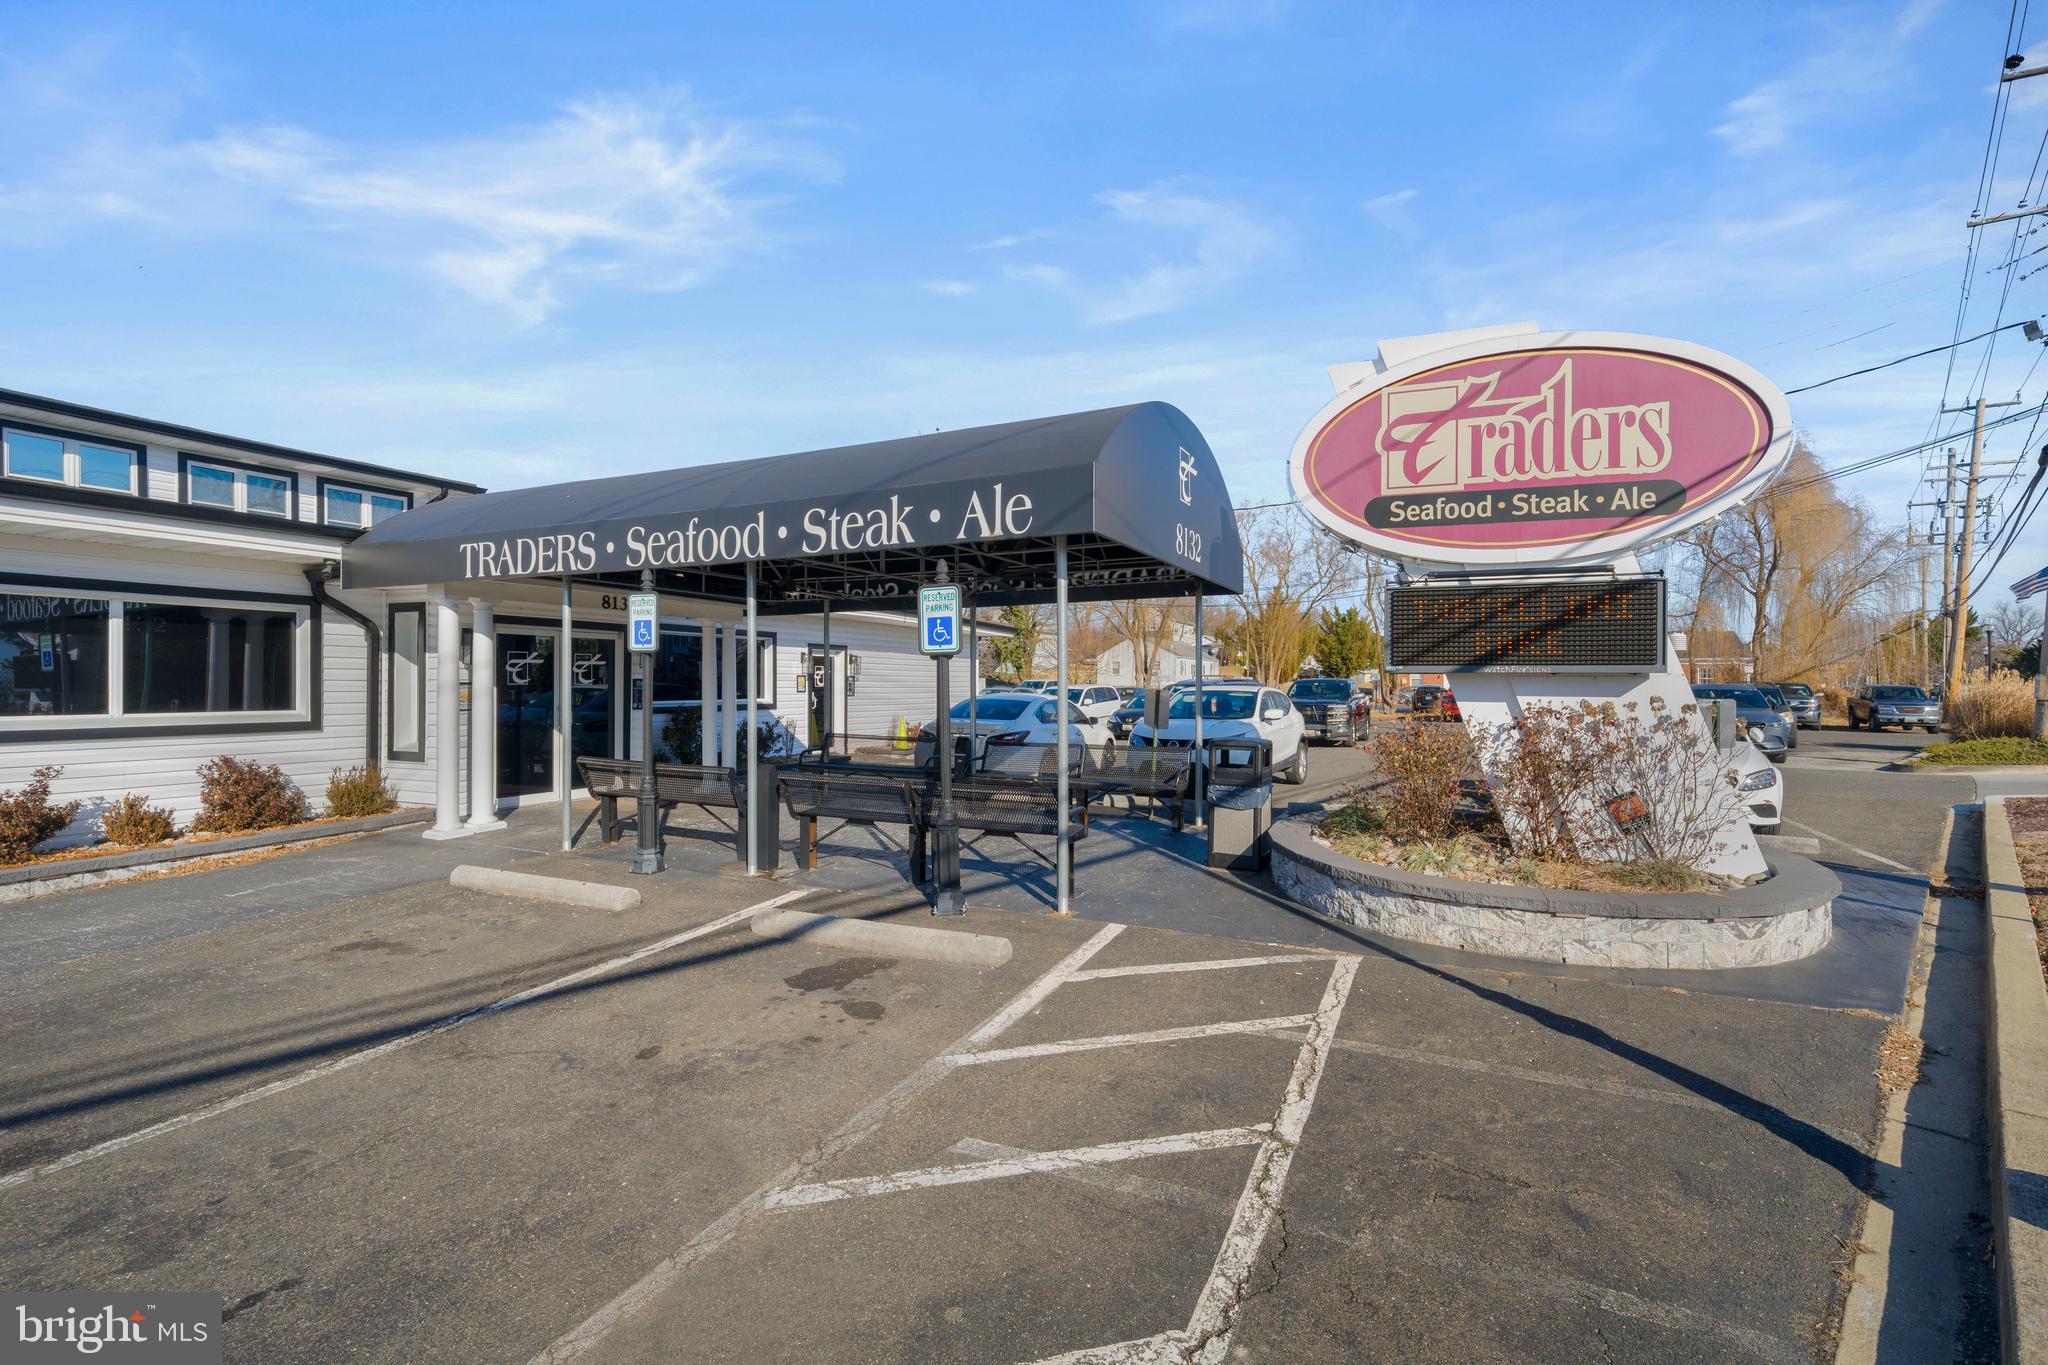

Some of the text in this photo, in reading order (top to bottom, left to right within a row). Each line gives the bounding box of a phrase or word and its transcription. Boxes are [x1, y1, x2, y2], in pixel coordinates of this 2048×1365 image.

[1375, 357, 1673, 492] Traders
[1389, 487, 1657, 522] Seafood Steak Ale
[459, 483, 1033, 578] TRADERS Seafood Steak Ale
[1175, 522, 1202, 563] 8132
[923, 593, 955, 602] RESERVED
[926, 604, 953, 612] PARKING
